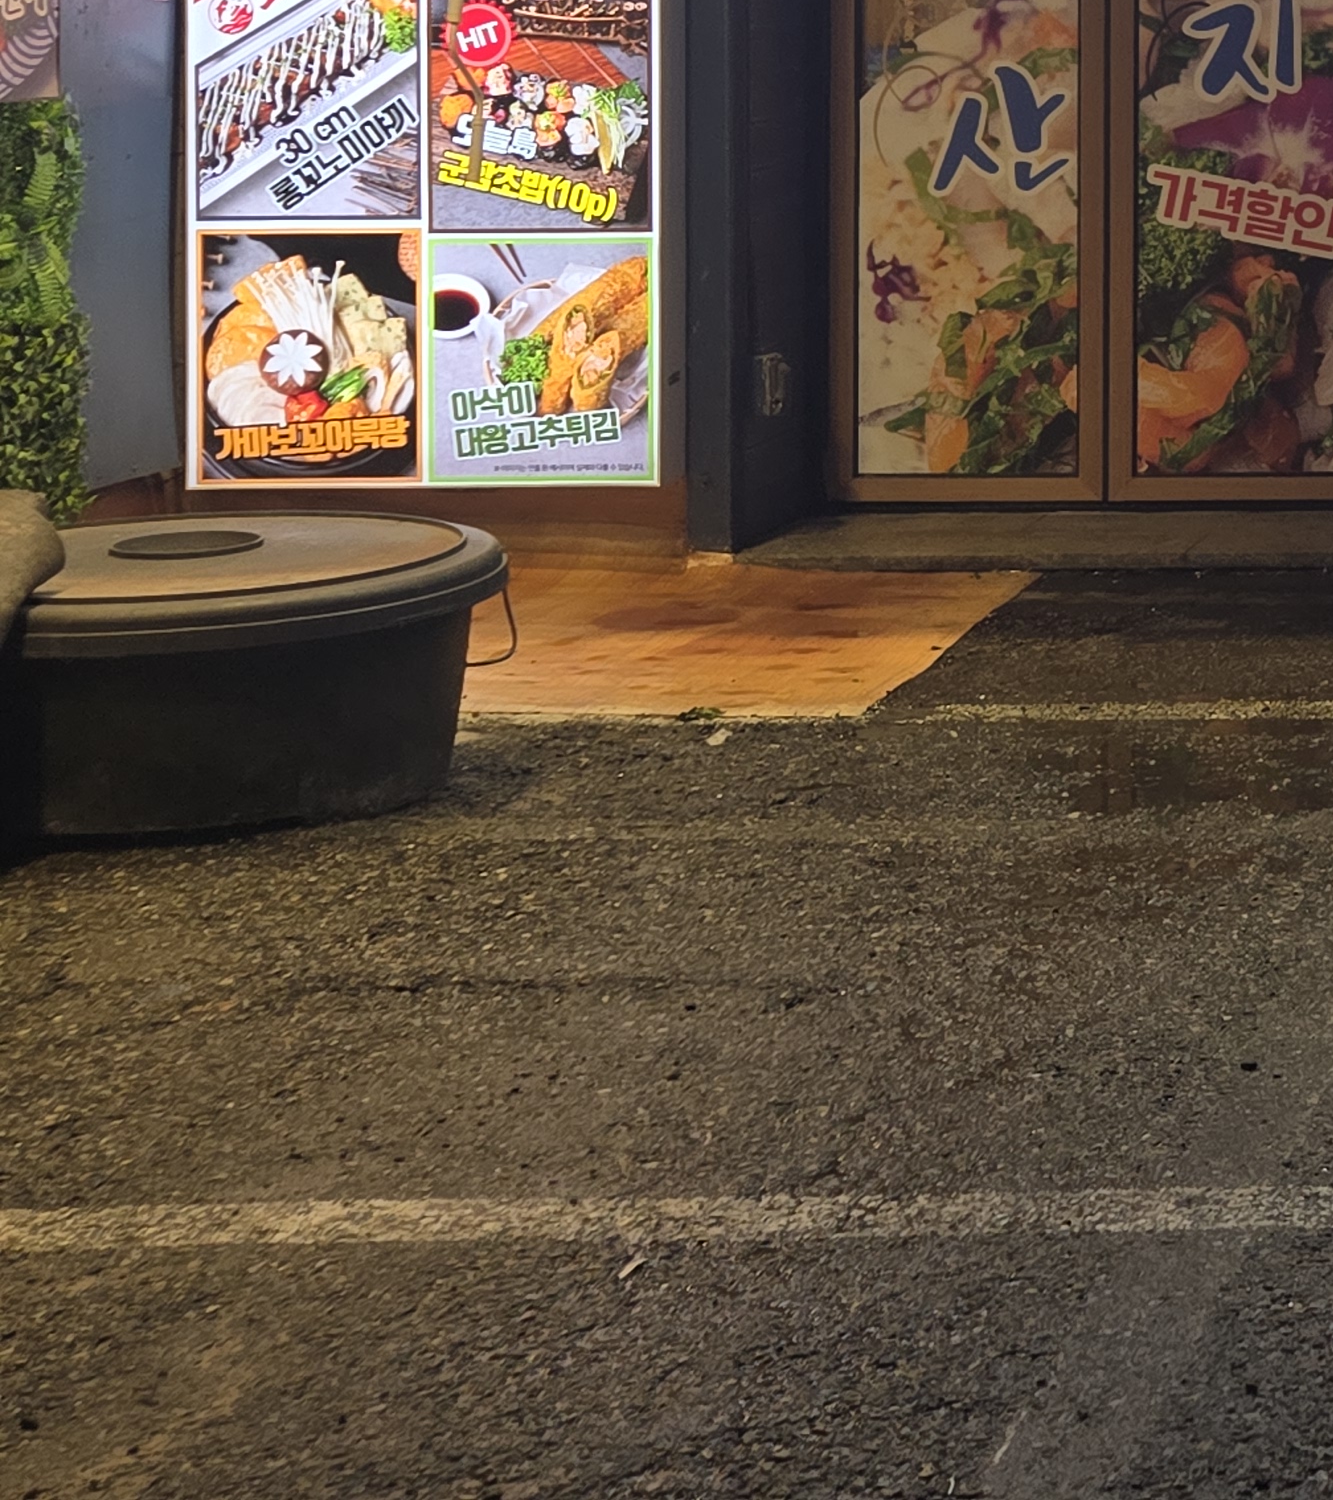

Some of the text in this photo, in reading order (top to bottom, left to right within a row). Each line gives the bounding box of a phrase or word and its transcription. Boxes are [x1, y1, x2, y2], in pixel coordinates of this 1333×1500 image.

[456, 20, 499, 53] HIT
[275, 128, 313, 164] 30
[451, 382, 536, 422] 아삭이
[454, 412, 619, 458] 대왕고추튀김
